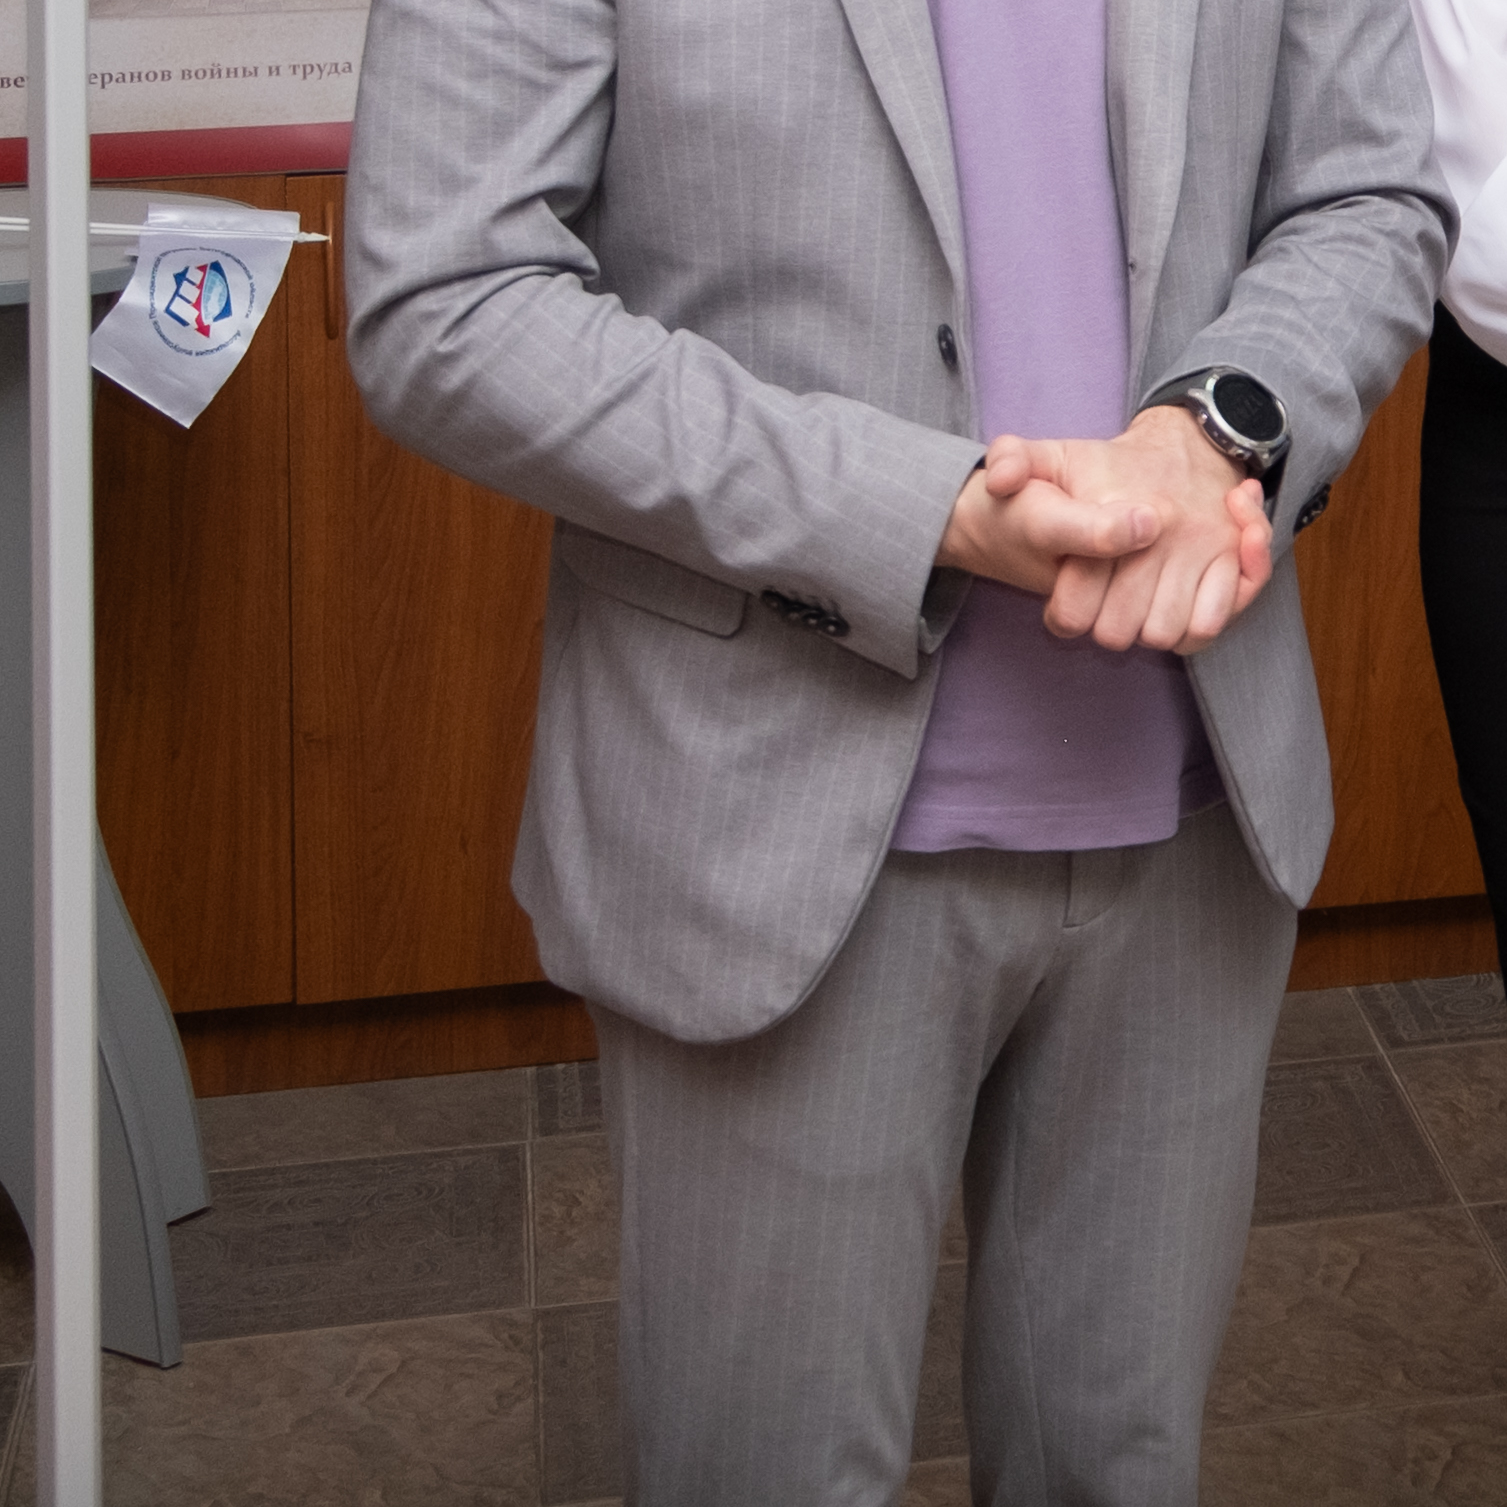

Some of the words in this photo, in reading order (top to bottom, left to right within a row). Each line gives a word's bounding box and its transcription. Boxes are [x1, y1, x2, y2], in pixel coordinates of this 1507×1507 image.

[88, 67, 172, 90] еранов
[180, 60, 259, 81] войны
[267, 63, 282, 78] и
[288, 59, 354, 82] труда
